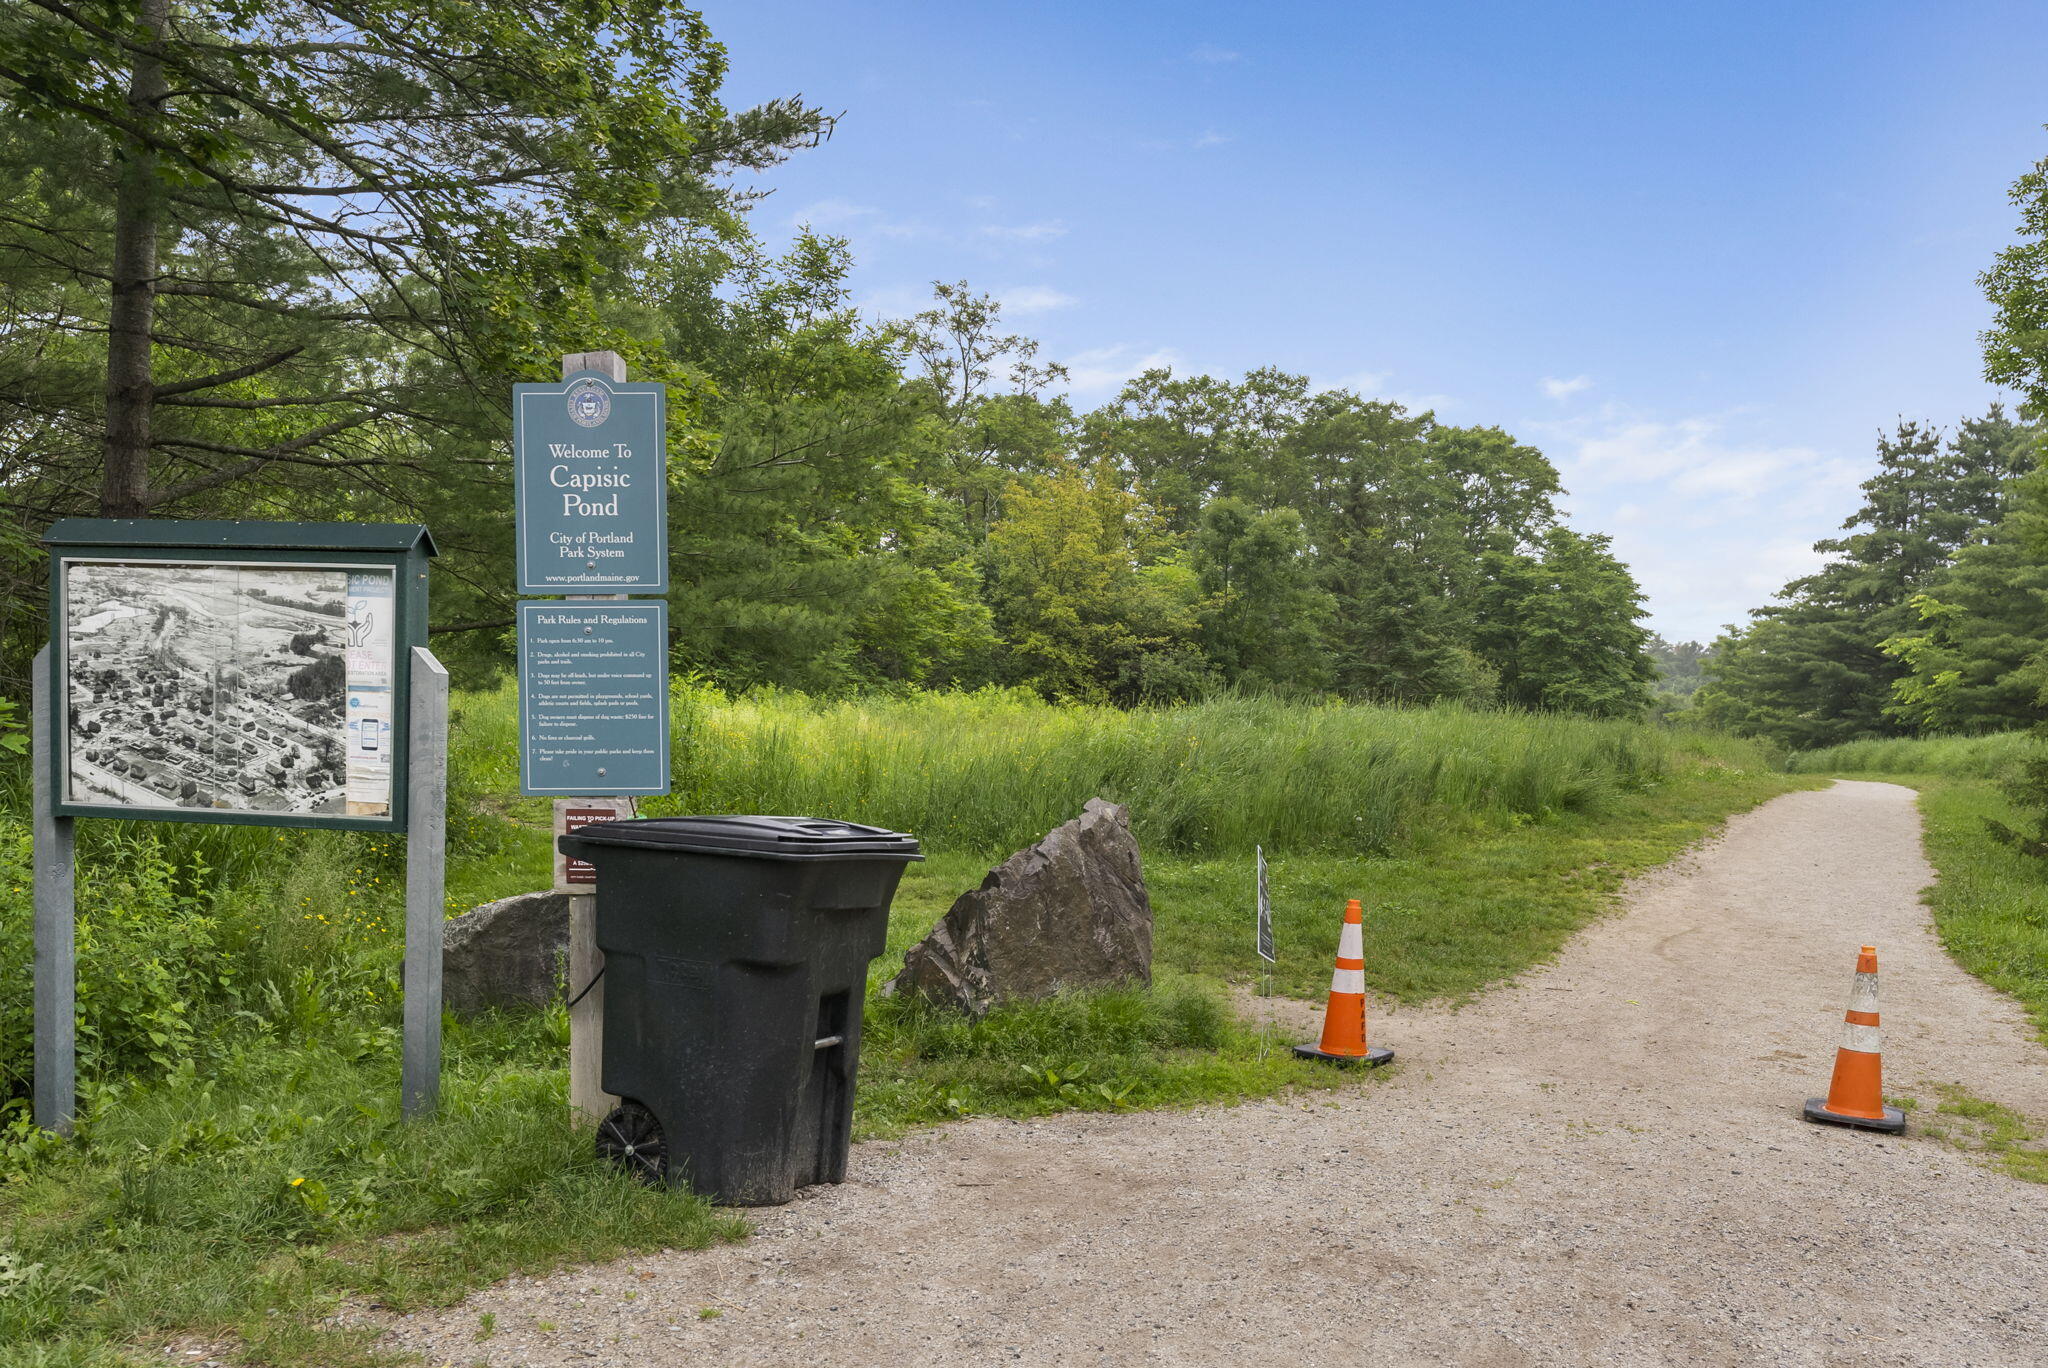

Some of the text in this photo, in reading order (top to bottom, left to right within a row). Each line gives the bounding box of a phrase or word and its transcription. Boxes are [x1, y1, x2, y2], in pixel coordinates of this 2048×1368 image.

[549, 443, 632, 459] Welcome To
[550, 465, 631, 492] Capisic
[563, 494, 619, 516] Pond
[550, 531, 633, 545] City of Portland
[560, 546, 625, 559] Park System
[362, 575, 389, 585] POND
[545, 573, 640, 583] www.portlandmaine.gov
[537, 615, 647, 626] Park Rules and Regulations
